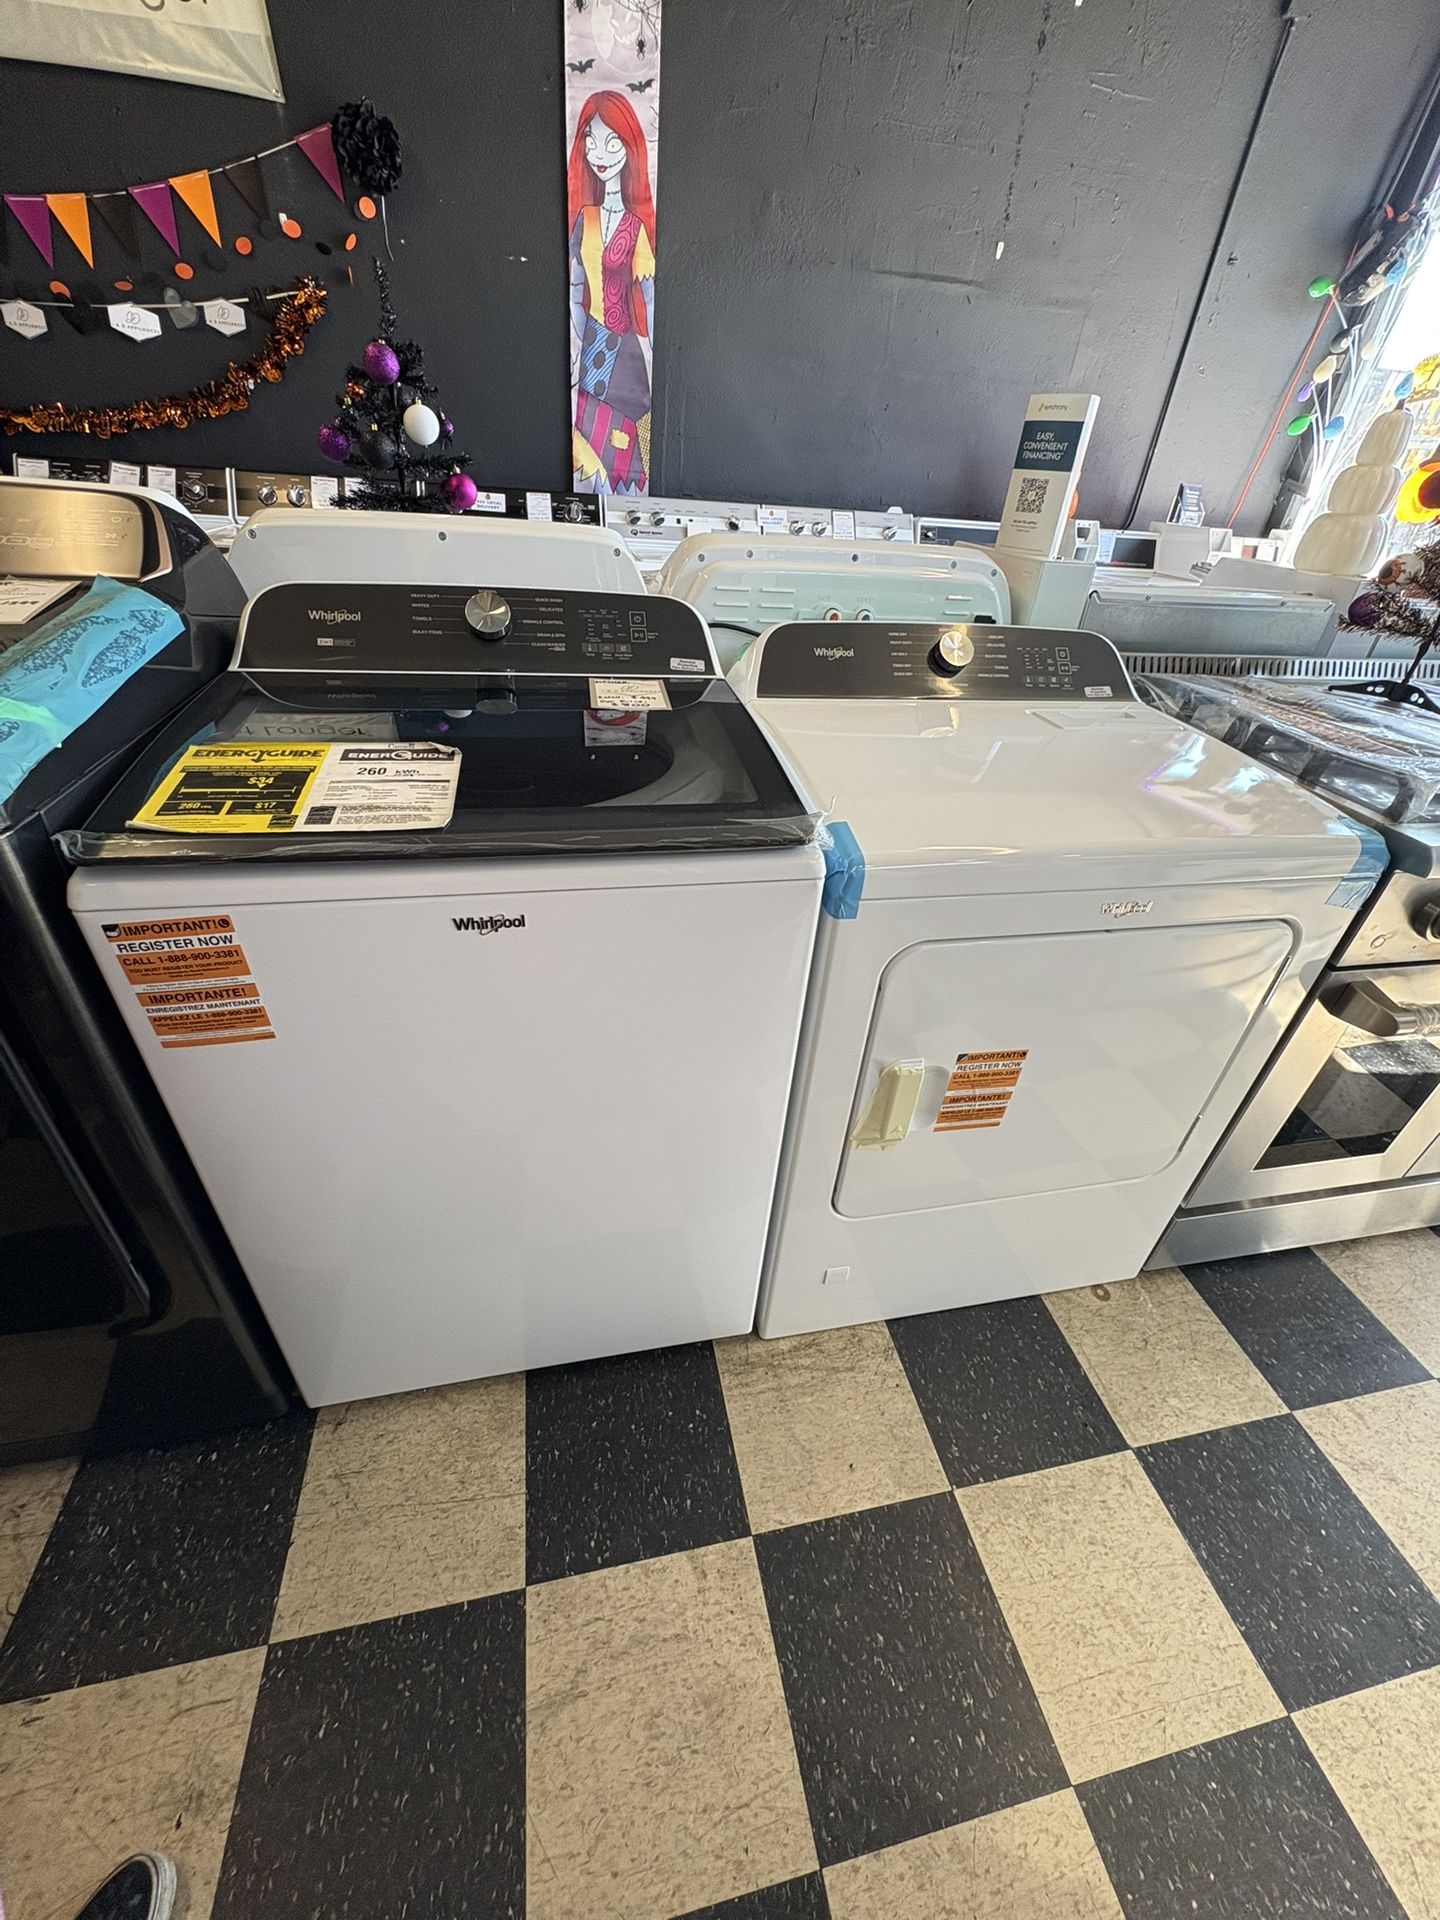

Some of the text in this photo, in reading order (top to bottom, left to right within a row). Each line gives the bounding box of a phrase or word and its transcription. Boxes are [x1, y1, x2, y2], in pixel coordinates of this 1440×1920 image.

[1036, 432, 1055, 441] EASY,
[1023, 441, 1069, 451] CONVENIENT
[308, 609, 361, 625] Whirlpool
[813, 647, 854, 661] Whirlpool
[192, 749, 325, 760] ENERGYGUIDE
[348, 750, 448, 760] ENERGUIDE
[356, 767, 387, 776] 260
[247, 777, 275, 785] $34
[122, 917, 218, 937] IMPORTANT!
[452, 914, 526, 935] Whirlpool
[116, 934, 233, 954] REGISTER NOW
[123, 949, 240, 967] CALL 1-888-900-3381
[148, 987, 246, 1004] IMPORTANTE!
[146, 999, 260, 1014] ENREGISTREZ MAINTENANT
[153, 1013, 190, 1023] APPELEZ
[967, 1051, 1020, 1061] IMPORTANT!
[957, 1061, 1022, 1072] REGISTER NOW
[949, 1094, 1006, 1104] IMPORTANTE!
